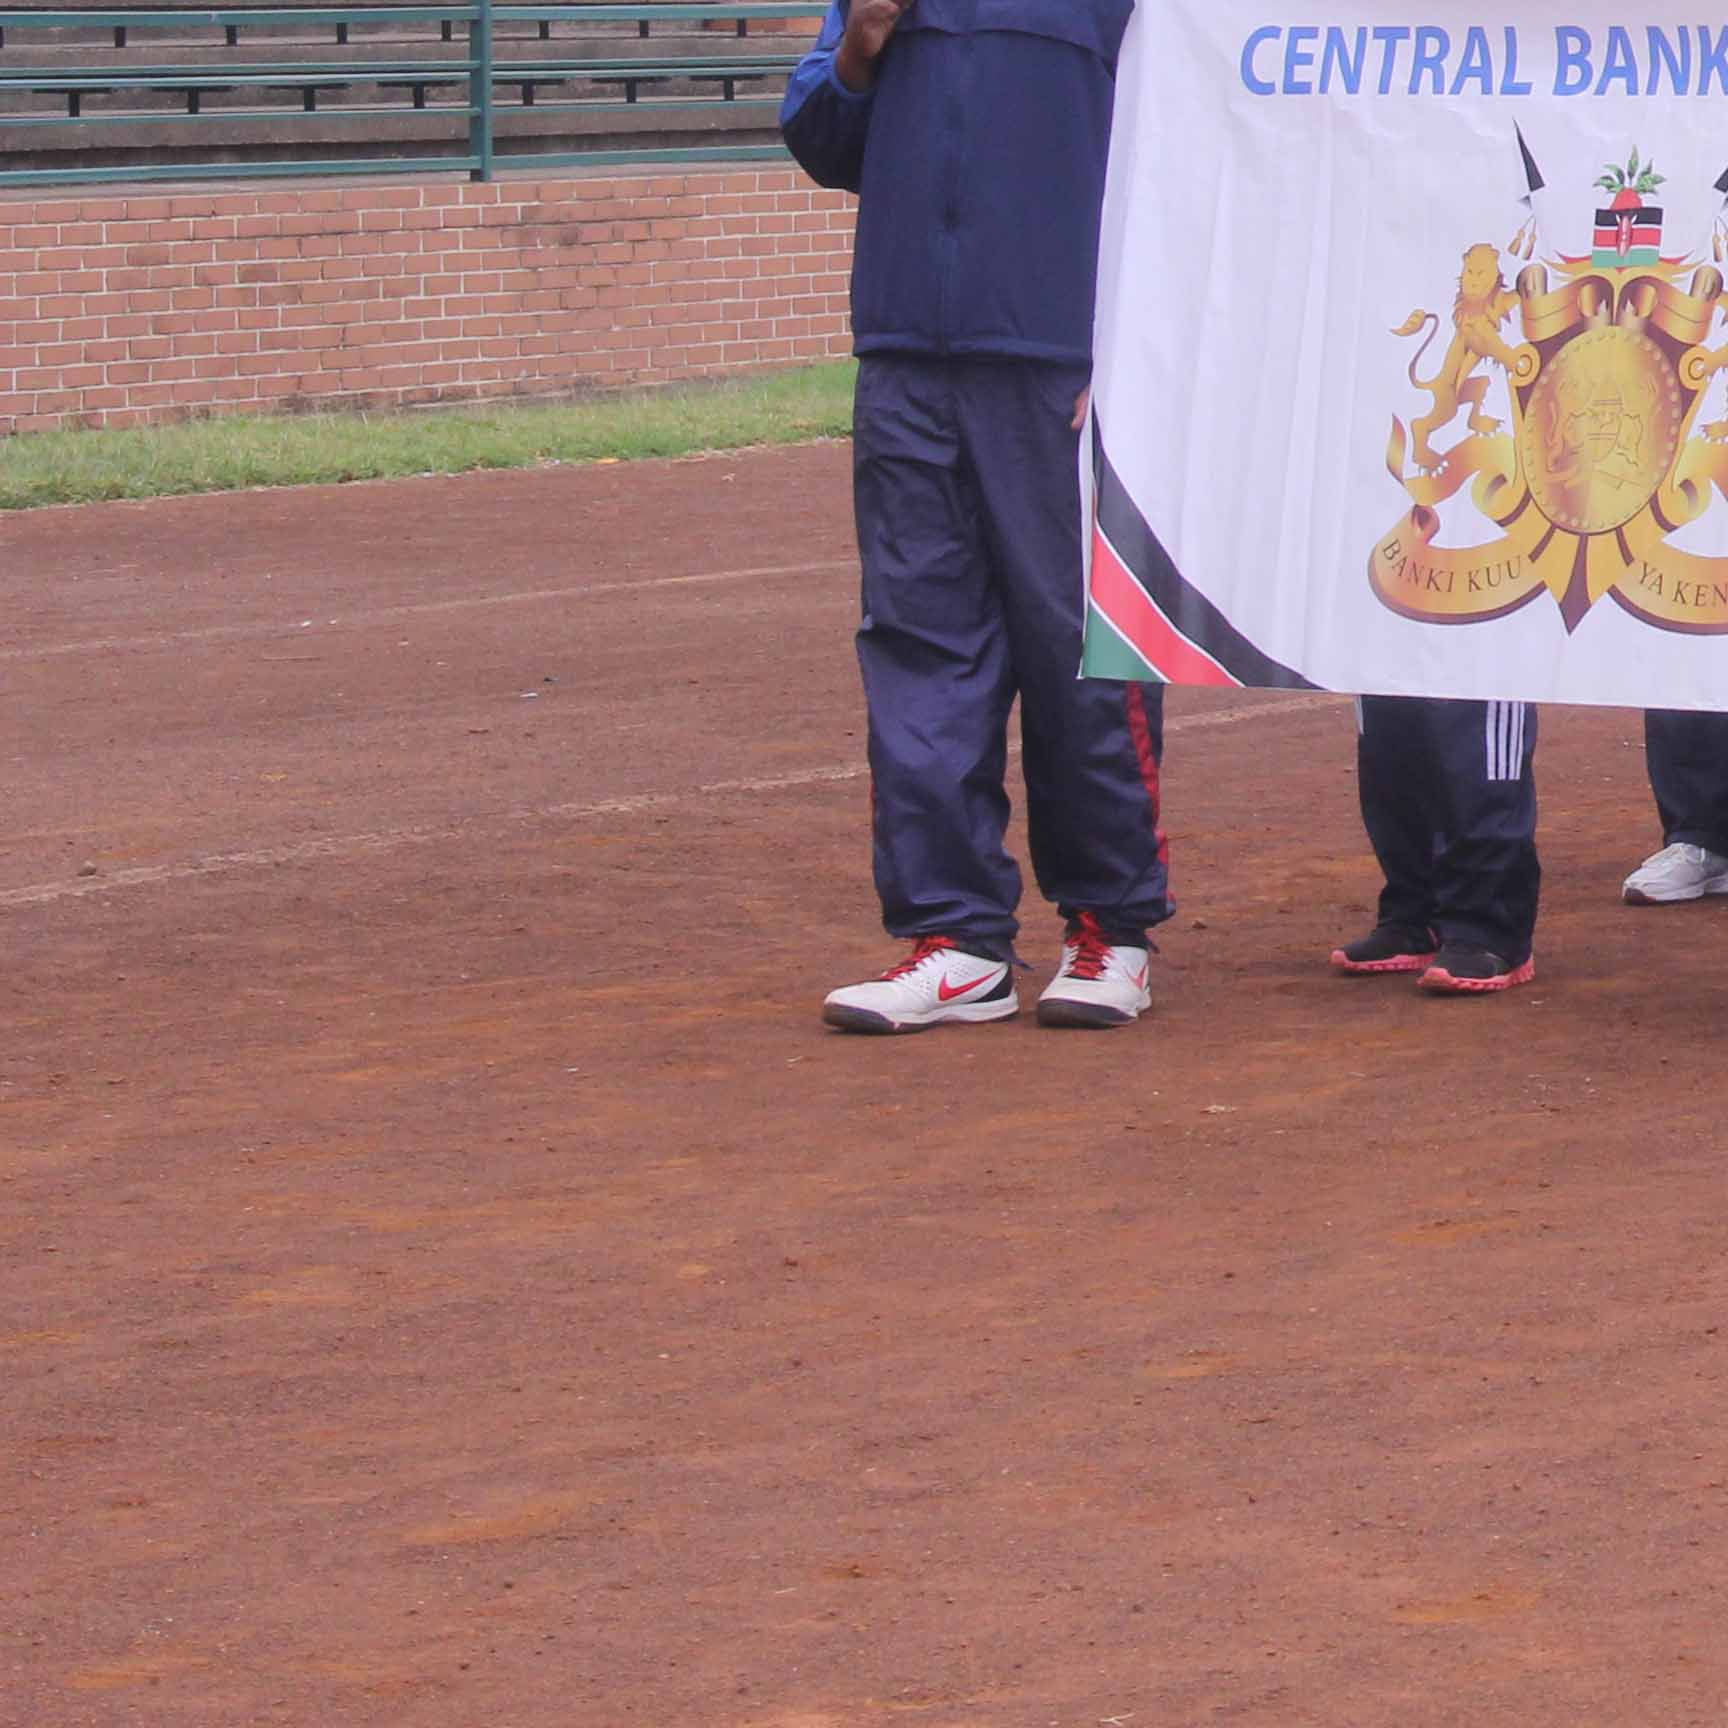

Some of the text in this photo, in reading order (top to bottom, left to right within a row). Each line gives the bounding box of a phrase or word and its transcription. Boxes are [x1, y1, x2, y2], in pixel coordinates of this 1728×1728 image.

[1240, 25, 1533, 96] CENTRAL
[1382, 539, 1522, 593] BANKI KUU
[1639, 561, 1664, 596] YA
